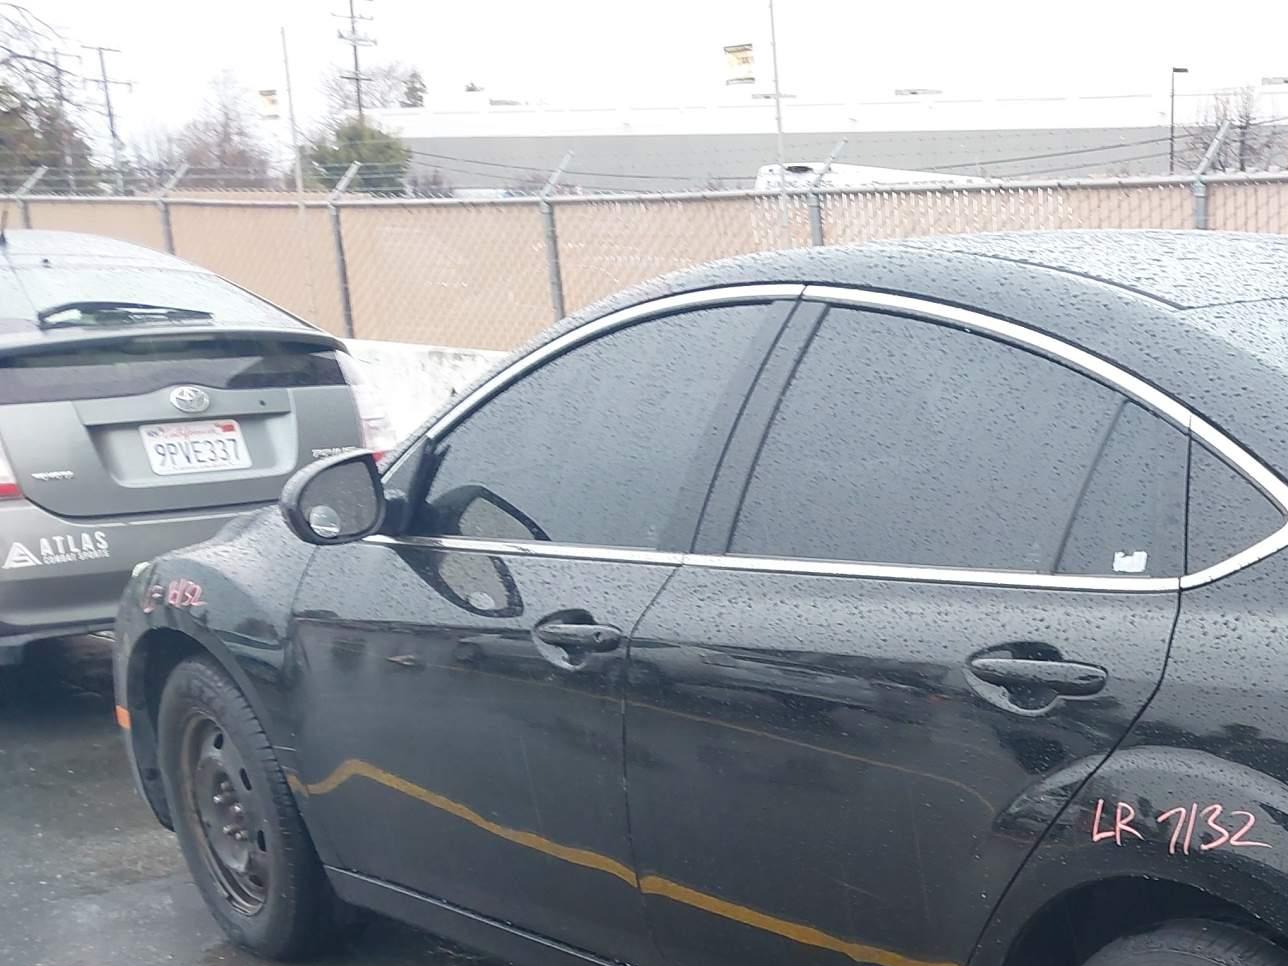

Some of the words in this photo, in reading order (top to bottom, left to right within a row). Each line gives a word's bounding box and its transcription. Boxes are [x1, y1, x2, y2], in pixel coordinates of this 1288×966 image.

[154, 438, 241, 466] 9PVE337
[39, 531, 109, 556] ATLAS
[1092, 799, 1145, 847] LR
